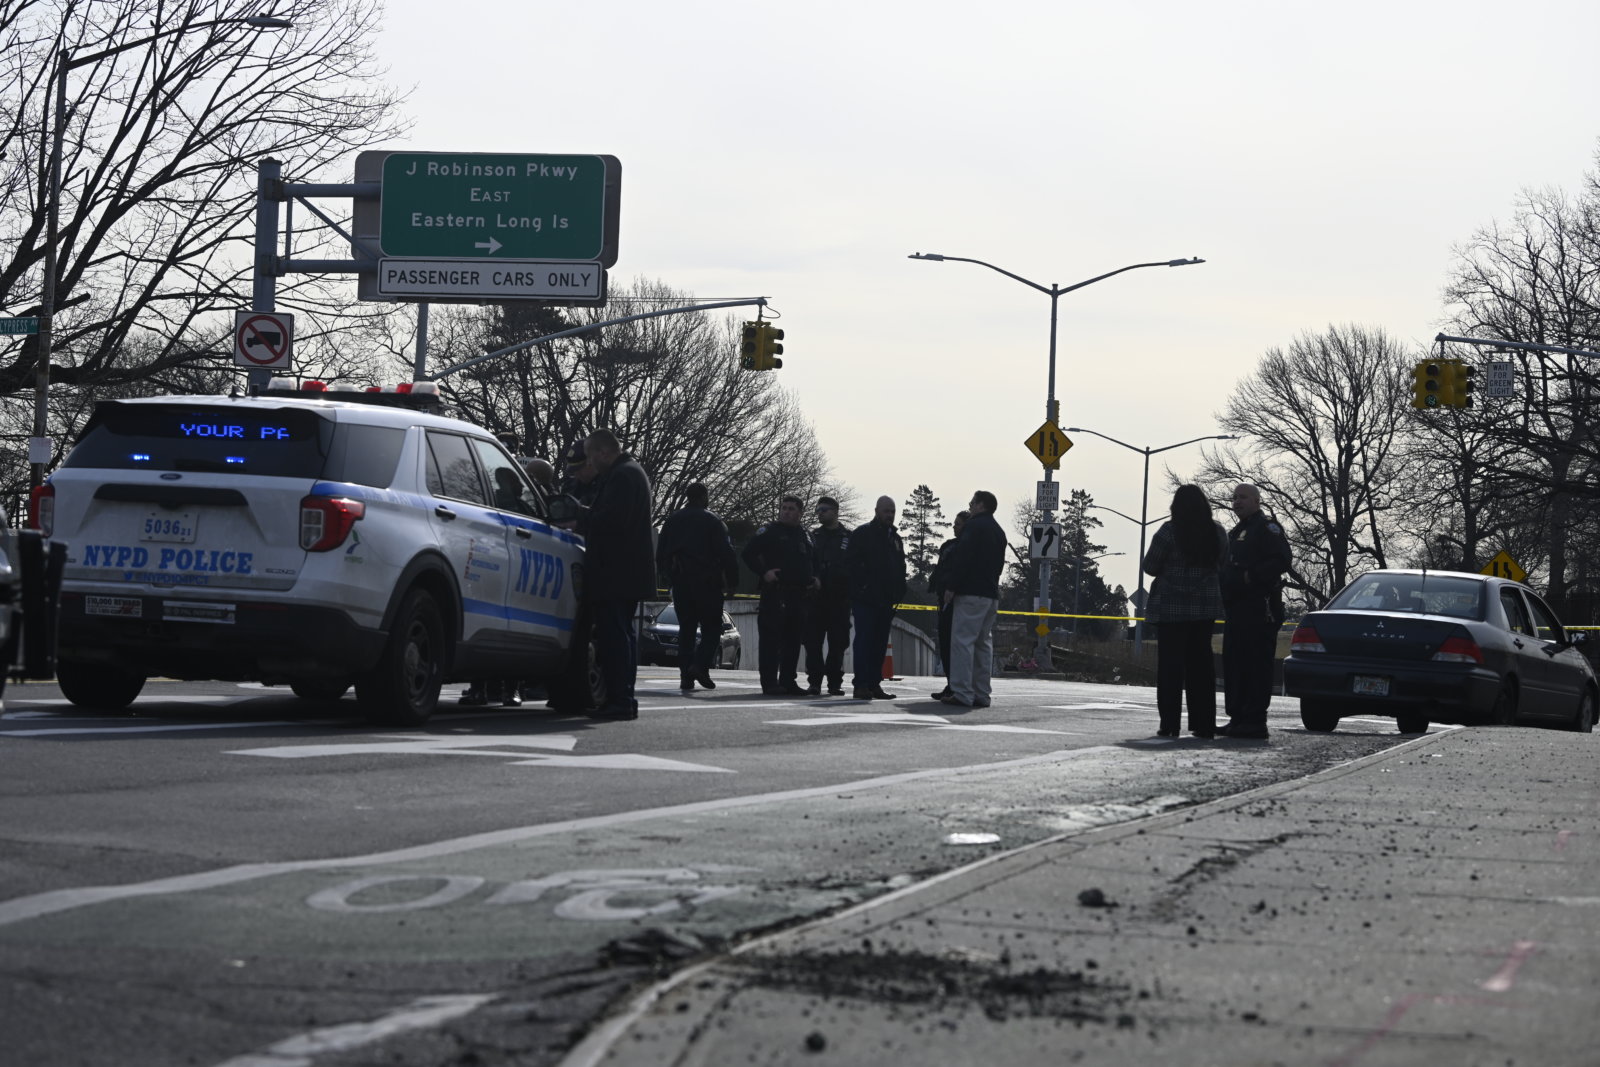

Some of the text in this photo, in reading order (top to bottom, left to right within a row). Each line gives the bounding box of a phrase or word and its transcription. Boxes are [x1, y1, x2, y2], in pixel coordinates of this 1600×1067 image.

[406, 161, 578, 181] J Robinson Pkwy
[470, 188, 511, 202] EAST
[411, 213, 569, 232] Eastern Long Is
[387, 270, 592, 287] PASSENGER CARS ONLY
[0, 319, 28, 332] CYPRESS
[1489, 379, 1512, 387] GREEN
[1490, 387, 1510, 395] LIGHT
[181, 423, 244, 438] YOUR
[144, 518, 181, 535] 5036
[83, 545, 254, 574] NYPD POLICE
[515, 547, 565, 600] NYPD
